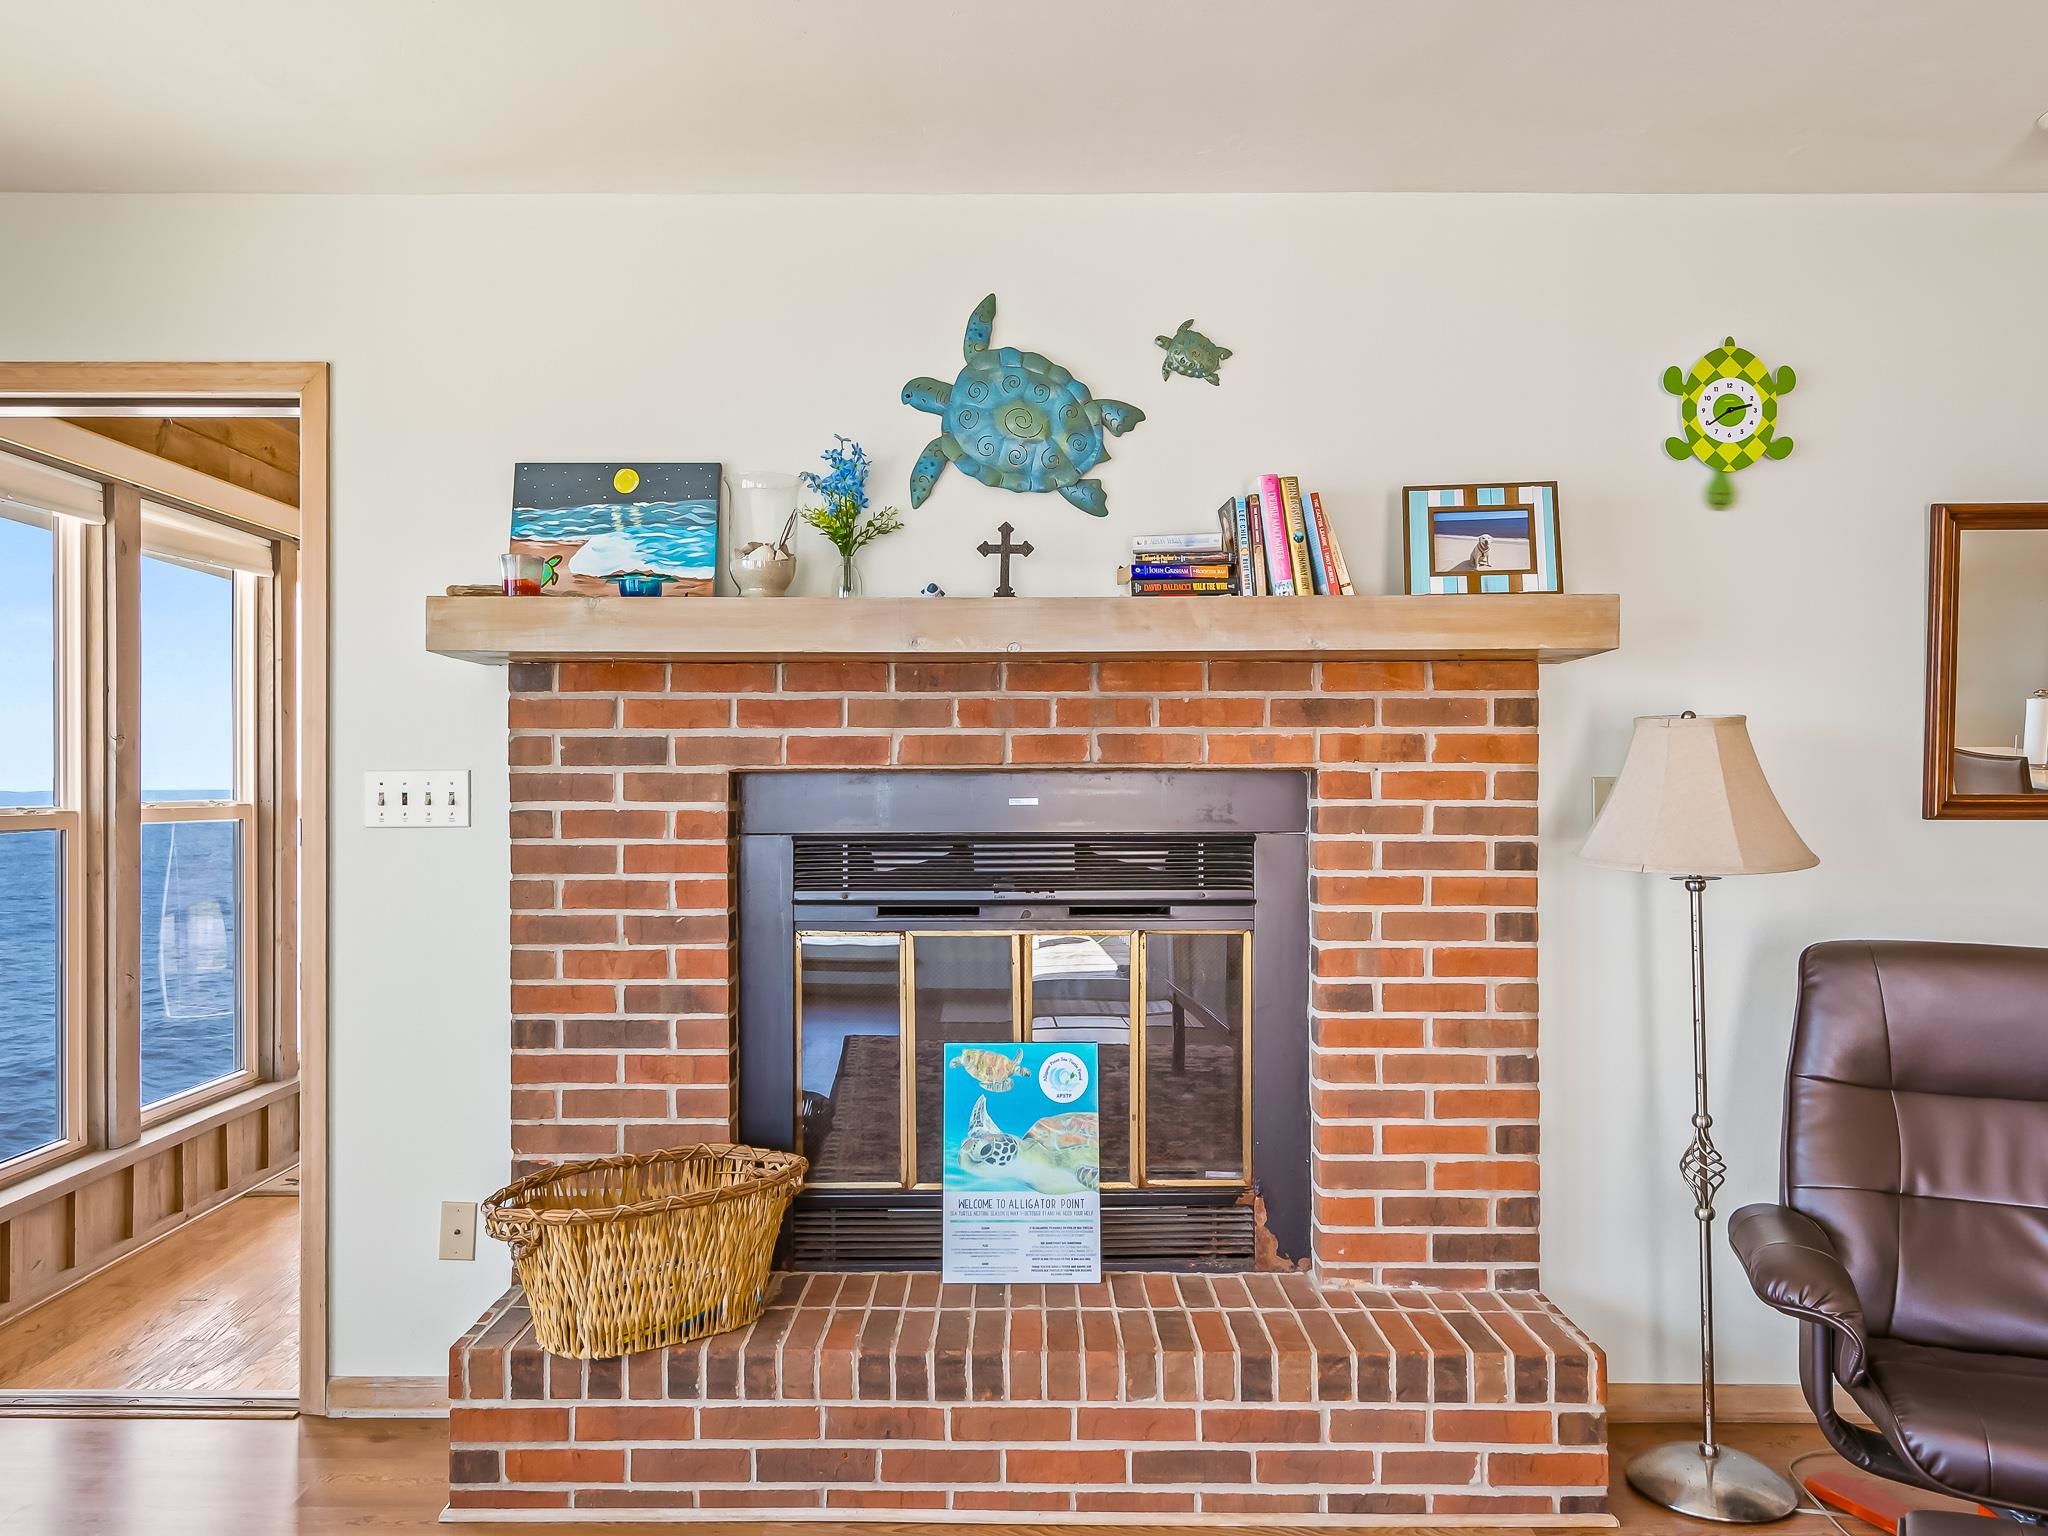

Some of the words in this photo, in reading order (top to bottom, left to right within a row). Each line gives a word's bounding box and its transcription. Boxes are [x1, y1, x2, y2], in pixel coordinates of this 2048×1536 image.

[1287, 480, 1297, 496] JOHN
[1267, 491, 1278, 519] DEBBIE
[1290, 499, 1301, 529] GRISHAM
[1315, 509, 1324, 528] CACTUS
[1320, 528, 1328, 547] LEAGUE
[1271, 519, 1284, 559] MACOMBER
[1149, 566, 1164, 575] JOHN
[1164, 566, 1189, 575] GRISHAM
[1143, 583, 1162, 592] DAVID
[1162, 583, 1192, 591] BALDACCI
[1243, 572, 1251, 590] MOON
[958, 1198, 993, 1209] WELCOME
[996, 1198, 1006, 1209] TO
[1008, 1198, 1056, 1209] ALLIGATOR
[1060, 1198, 1085, 1209] POINT
